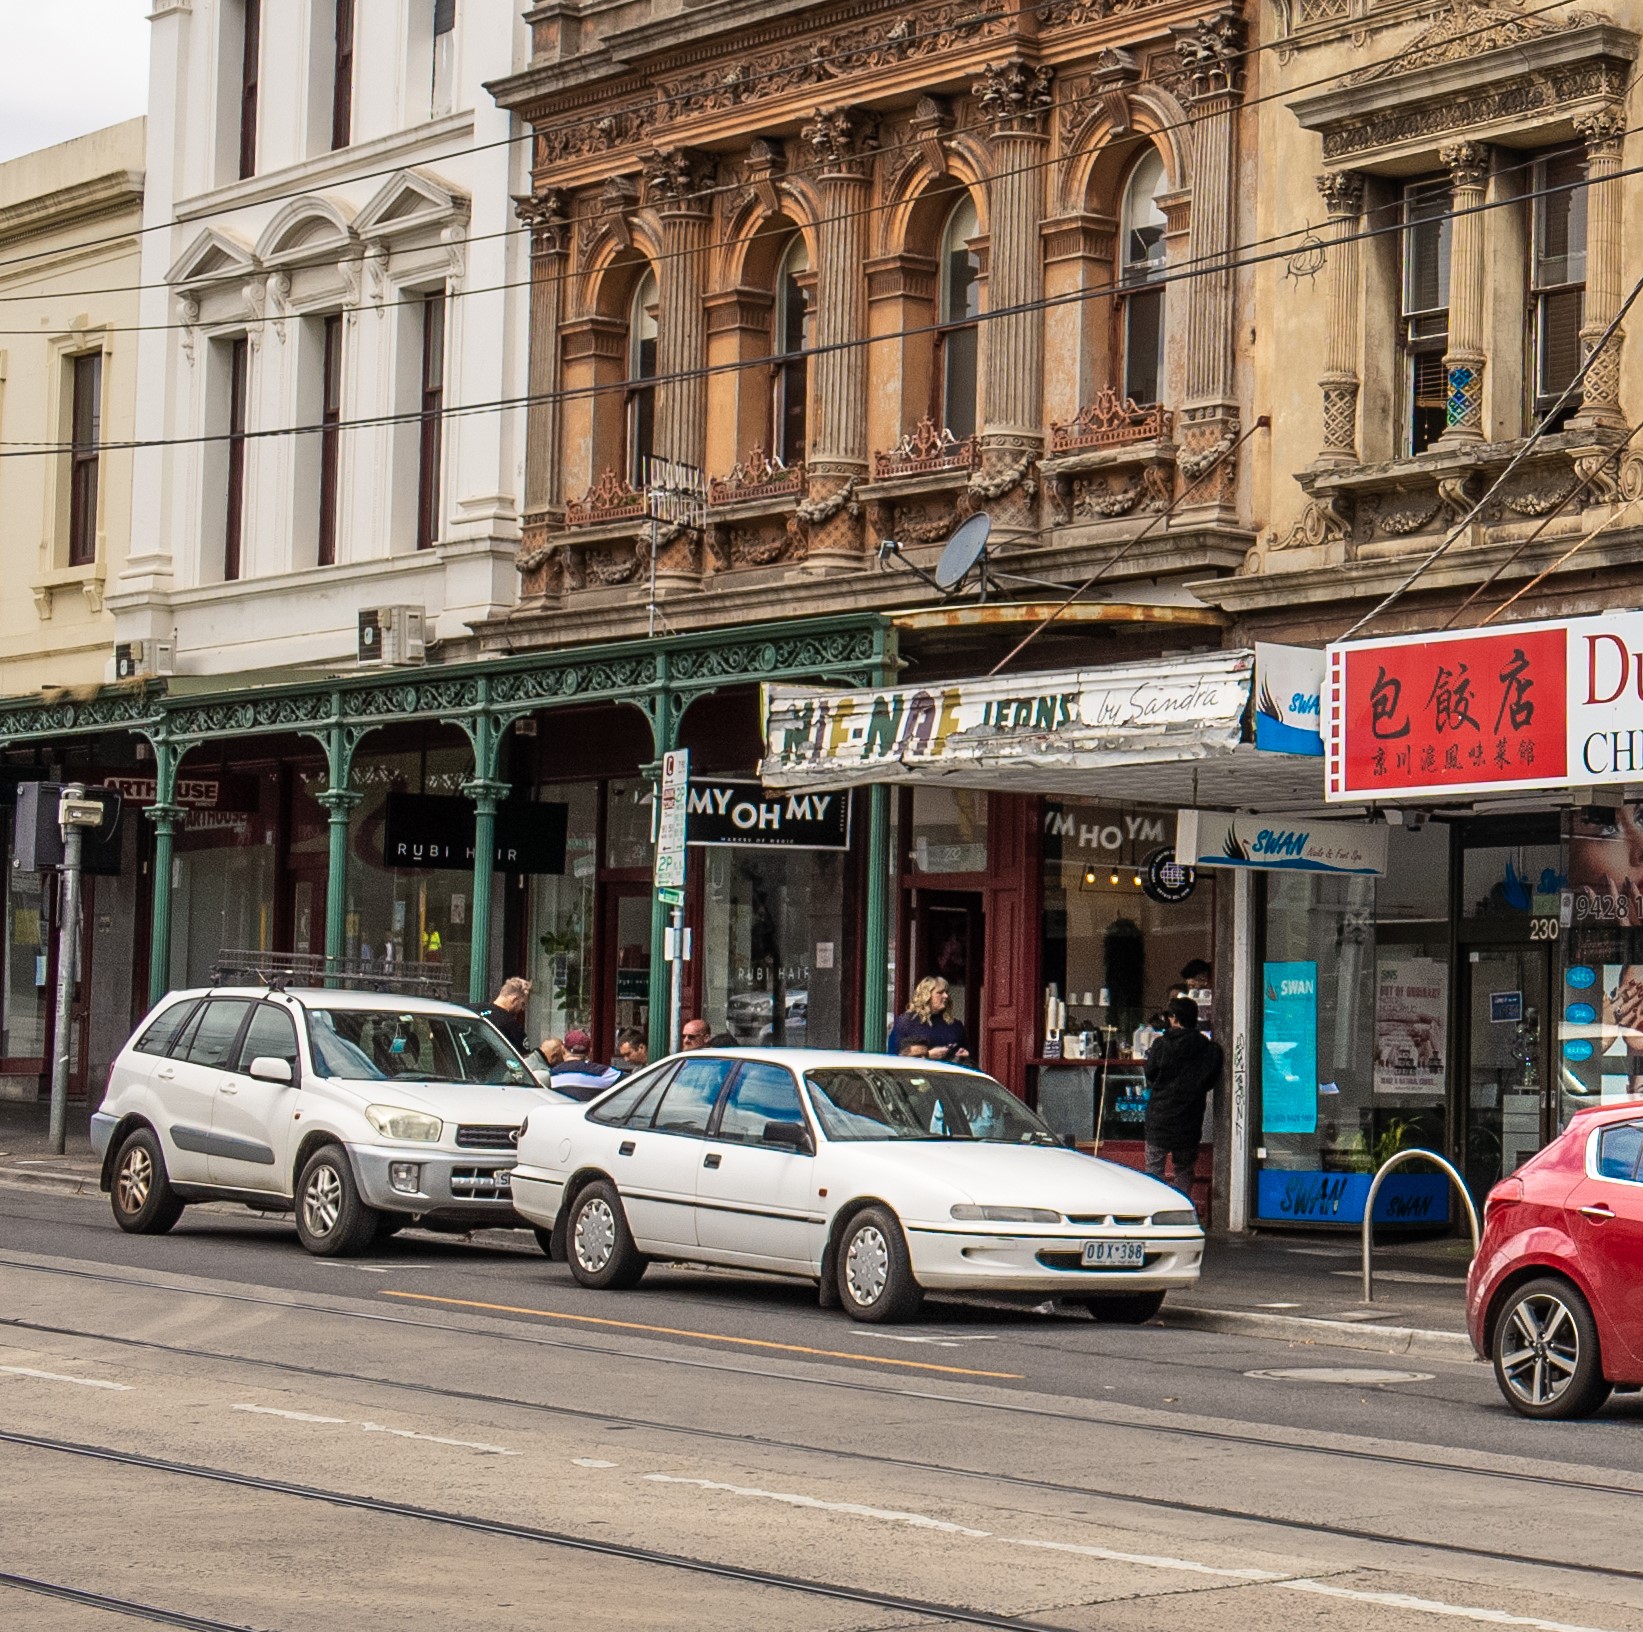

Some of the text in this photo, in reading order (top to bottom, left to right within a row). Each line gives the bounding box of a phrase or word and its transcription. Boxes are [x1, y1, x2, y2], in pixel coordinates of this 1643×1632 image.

[1096, 690, 1122, 725] by
[1129, 674, 1220, 720] Sandra
[1289, 692, 1320, 715] SWA
[688, 788, 734, 815] MY
[786, 795, 832, 820] MY
[732, 803, 781, 829] OH
[398, 843, 517, 861] RUBI HIR
[1252, 829, 1310, 856] SWAN
[658, 856, 673, 872] 2P
[1575, 893, 1629, 920] 9428
[1529, 919, 1559, 940] 230
[1281, 980, 1314, 996] SWAN
[1280, 1178, 1347, 1215] SWAN
[1386, 1196, 1433, 1217] SWAN
